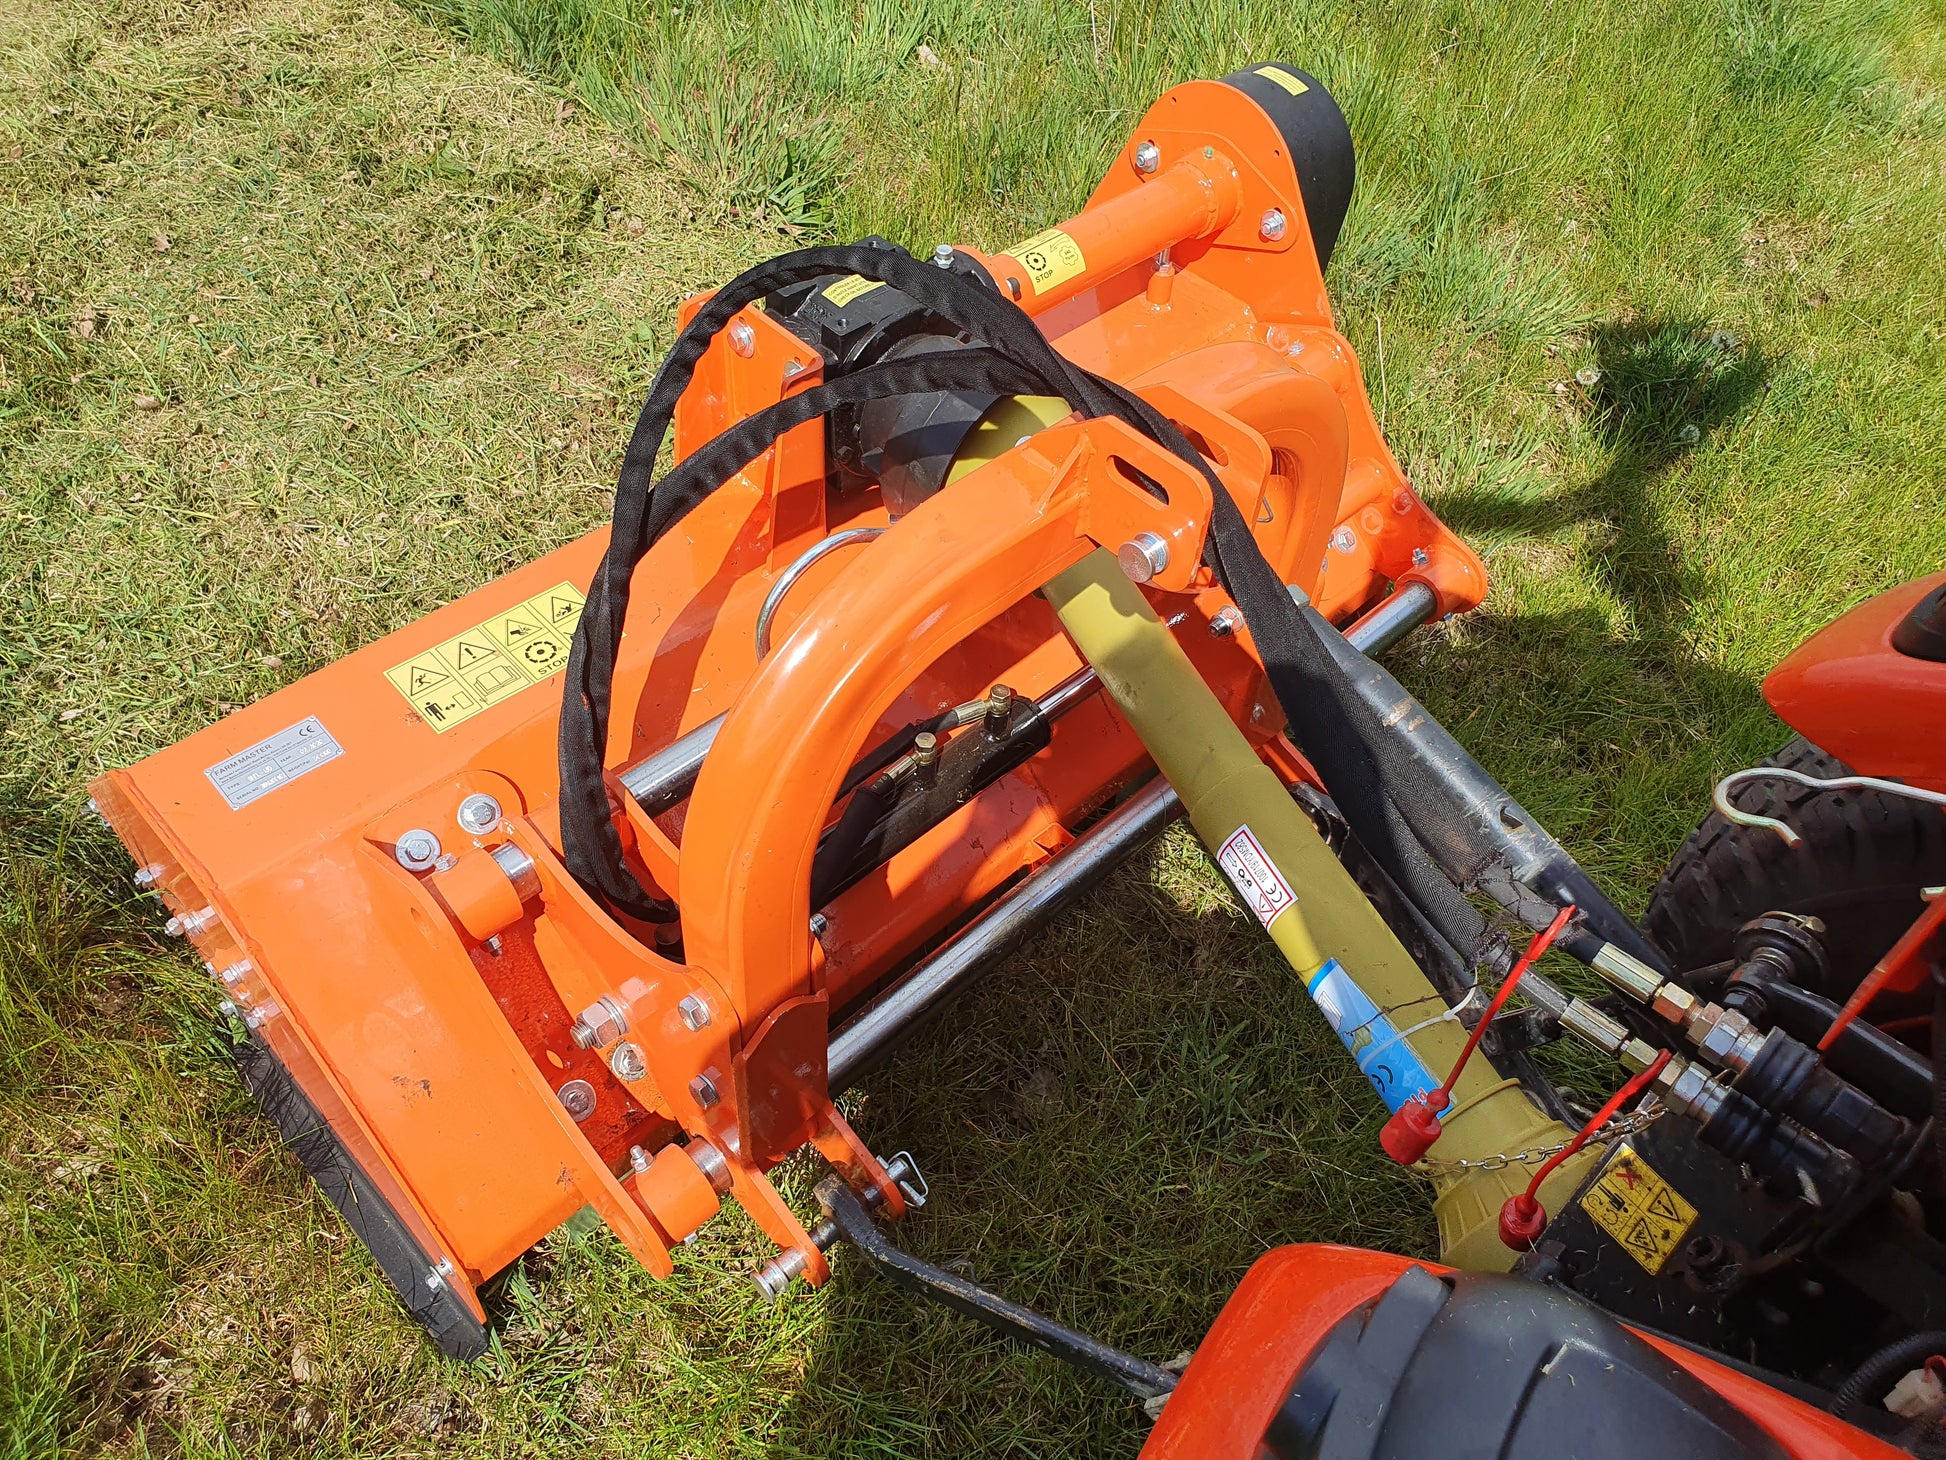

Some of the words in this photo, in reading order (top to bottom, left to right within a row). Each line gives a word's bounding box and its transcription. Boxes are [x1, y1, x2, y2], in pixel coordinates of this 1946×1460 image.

[1035, 269, 1053, 283] STOP
[538, 655, 568, 675] STOP
[214, 761, 239, 777] FARM
[239, 744, 272, 764] MASTER
